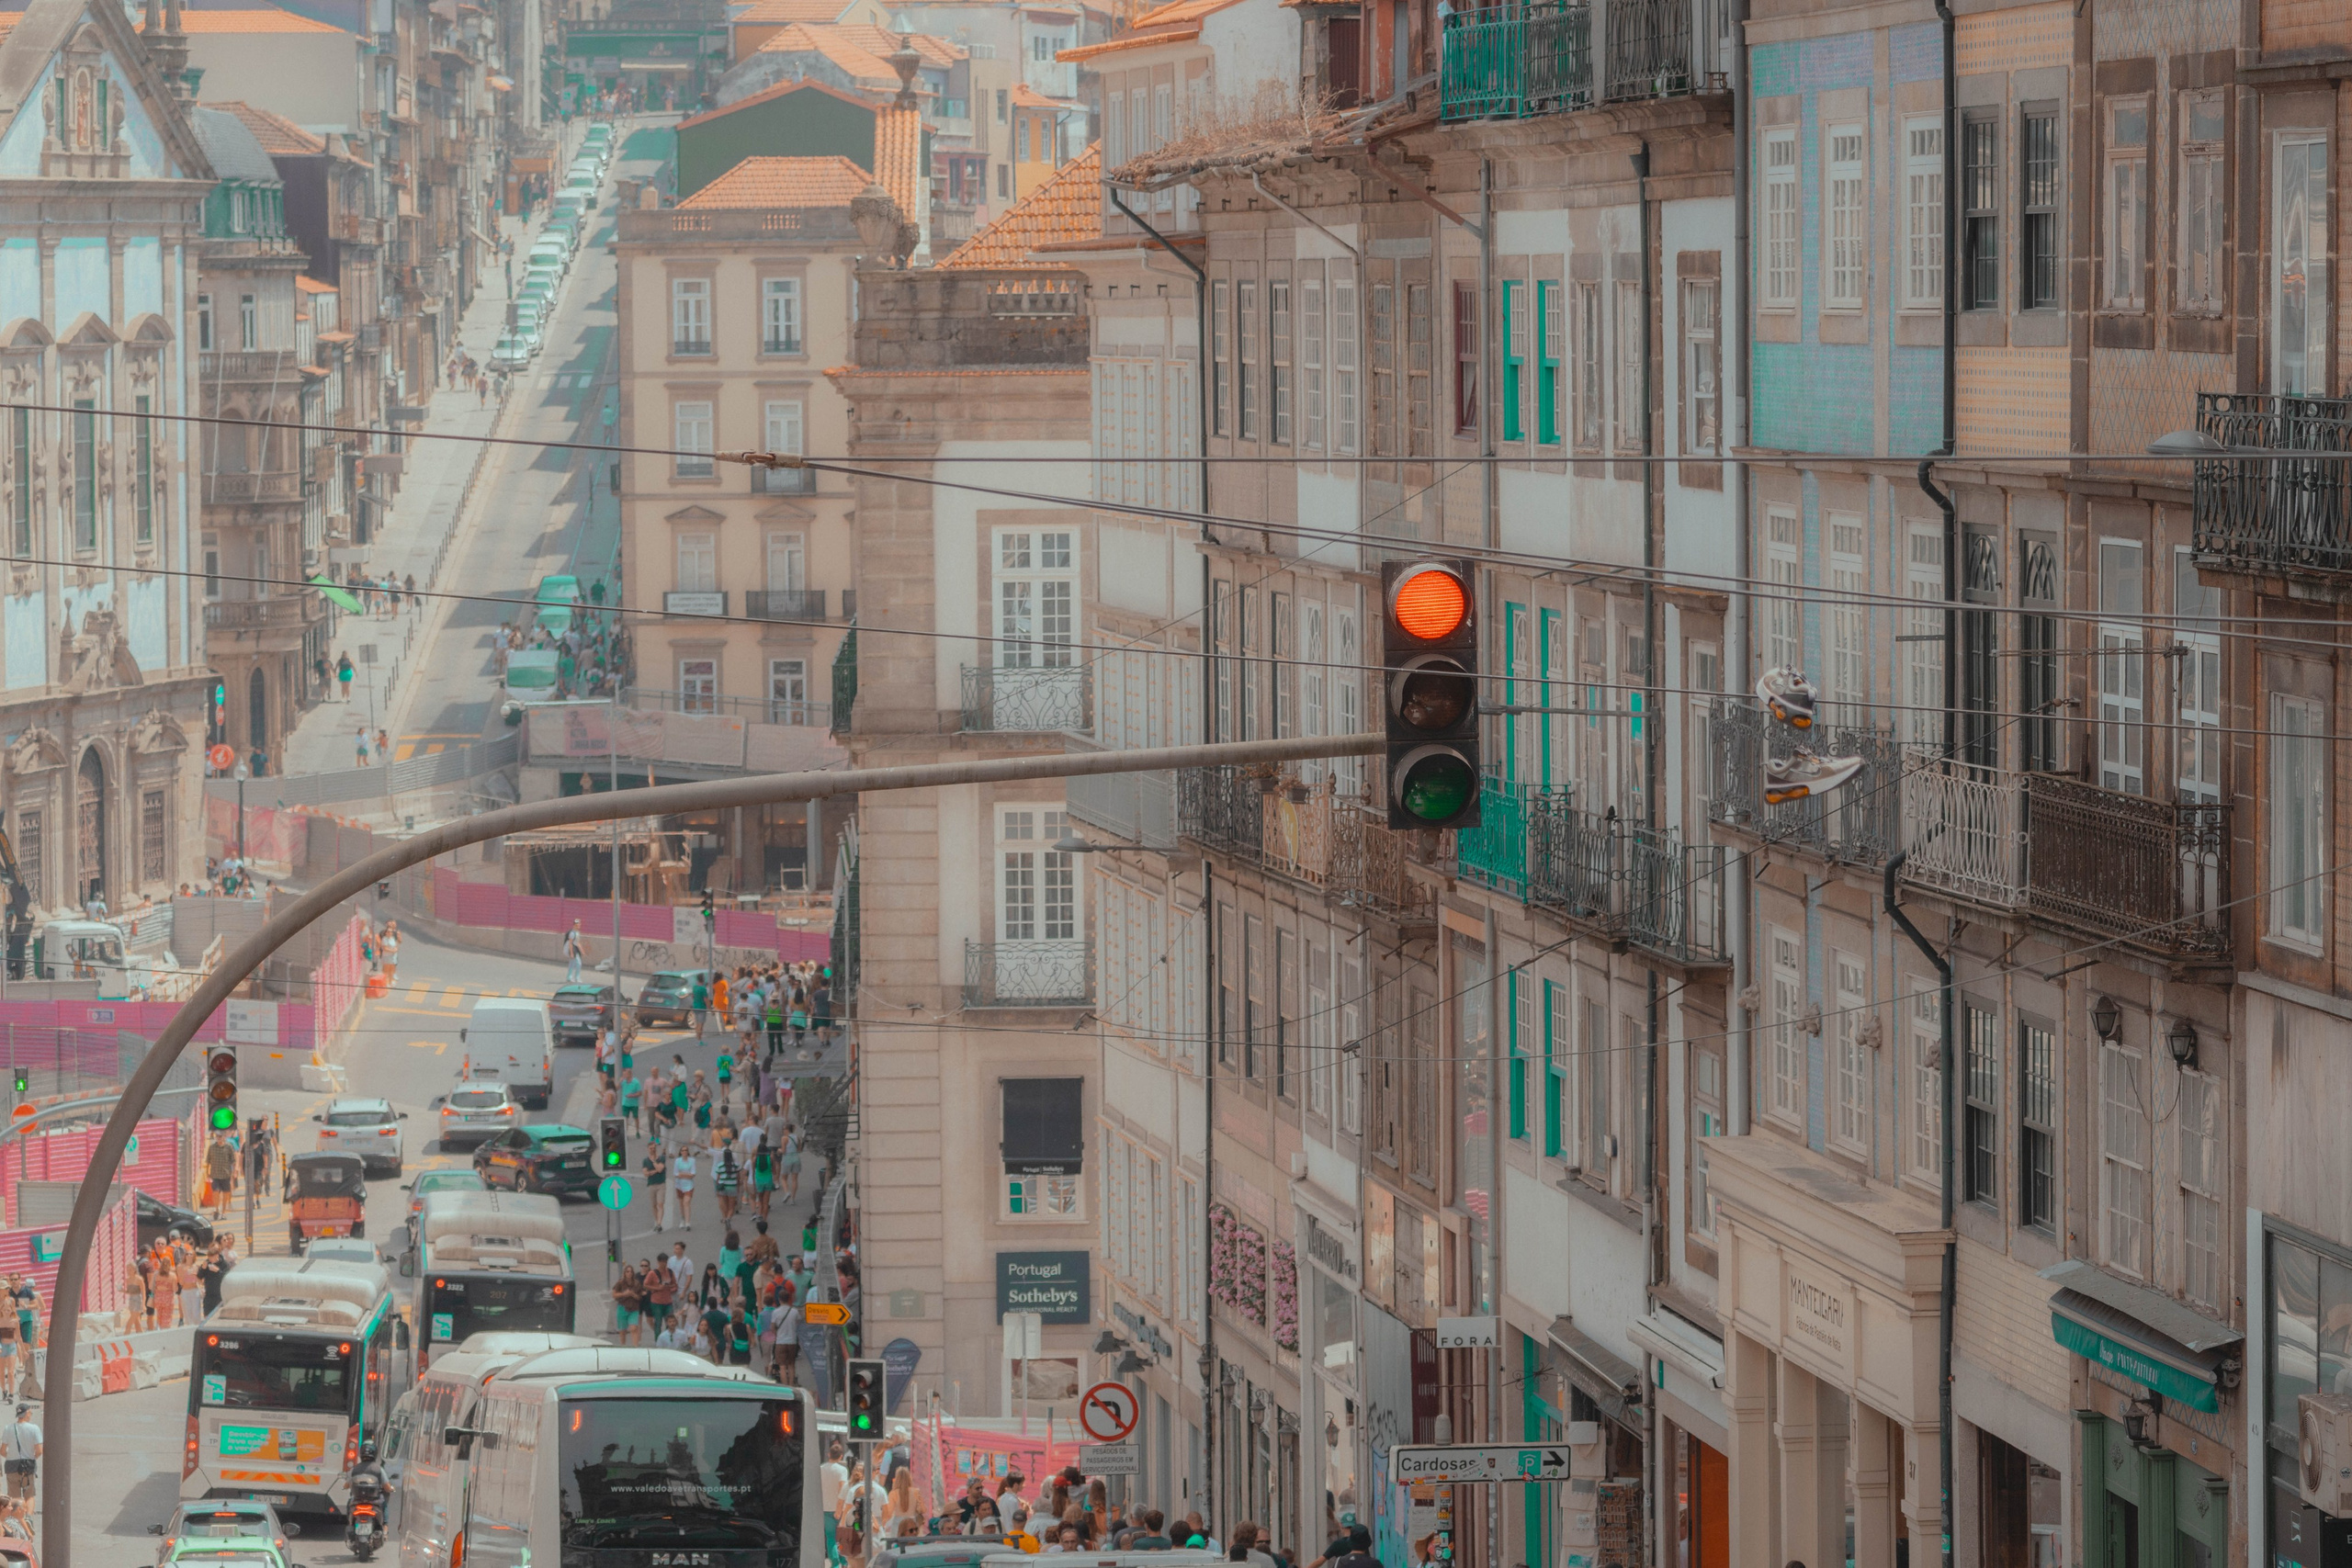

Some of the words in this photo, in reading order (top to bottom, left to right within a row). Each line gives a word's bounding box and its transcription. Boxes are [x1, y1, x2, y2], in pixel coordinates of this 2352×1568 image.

[1008, 1262, 1062, 1278] Portugal
[489, 1291, 507, 1300] 207
[1008, 1287, 1079, 1305] Sotheby's
[808, 1306, 830, 1314] Desvio
[1441, 1337, 1493, 1347] FORA
[1086, 1456, 1125, 1464] PASSAGEIROS
[1401, 1457, 1476, 1472] Cardosas
[610, 1483, 752, 1494] www.valedoavetransportes.pt
[651, 1552, 710, 1566] MAN
